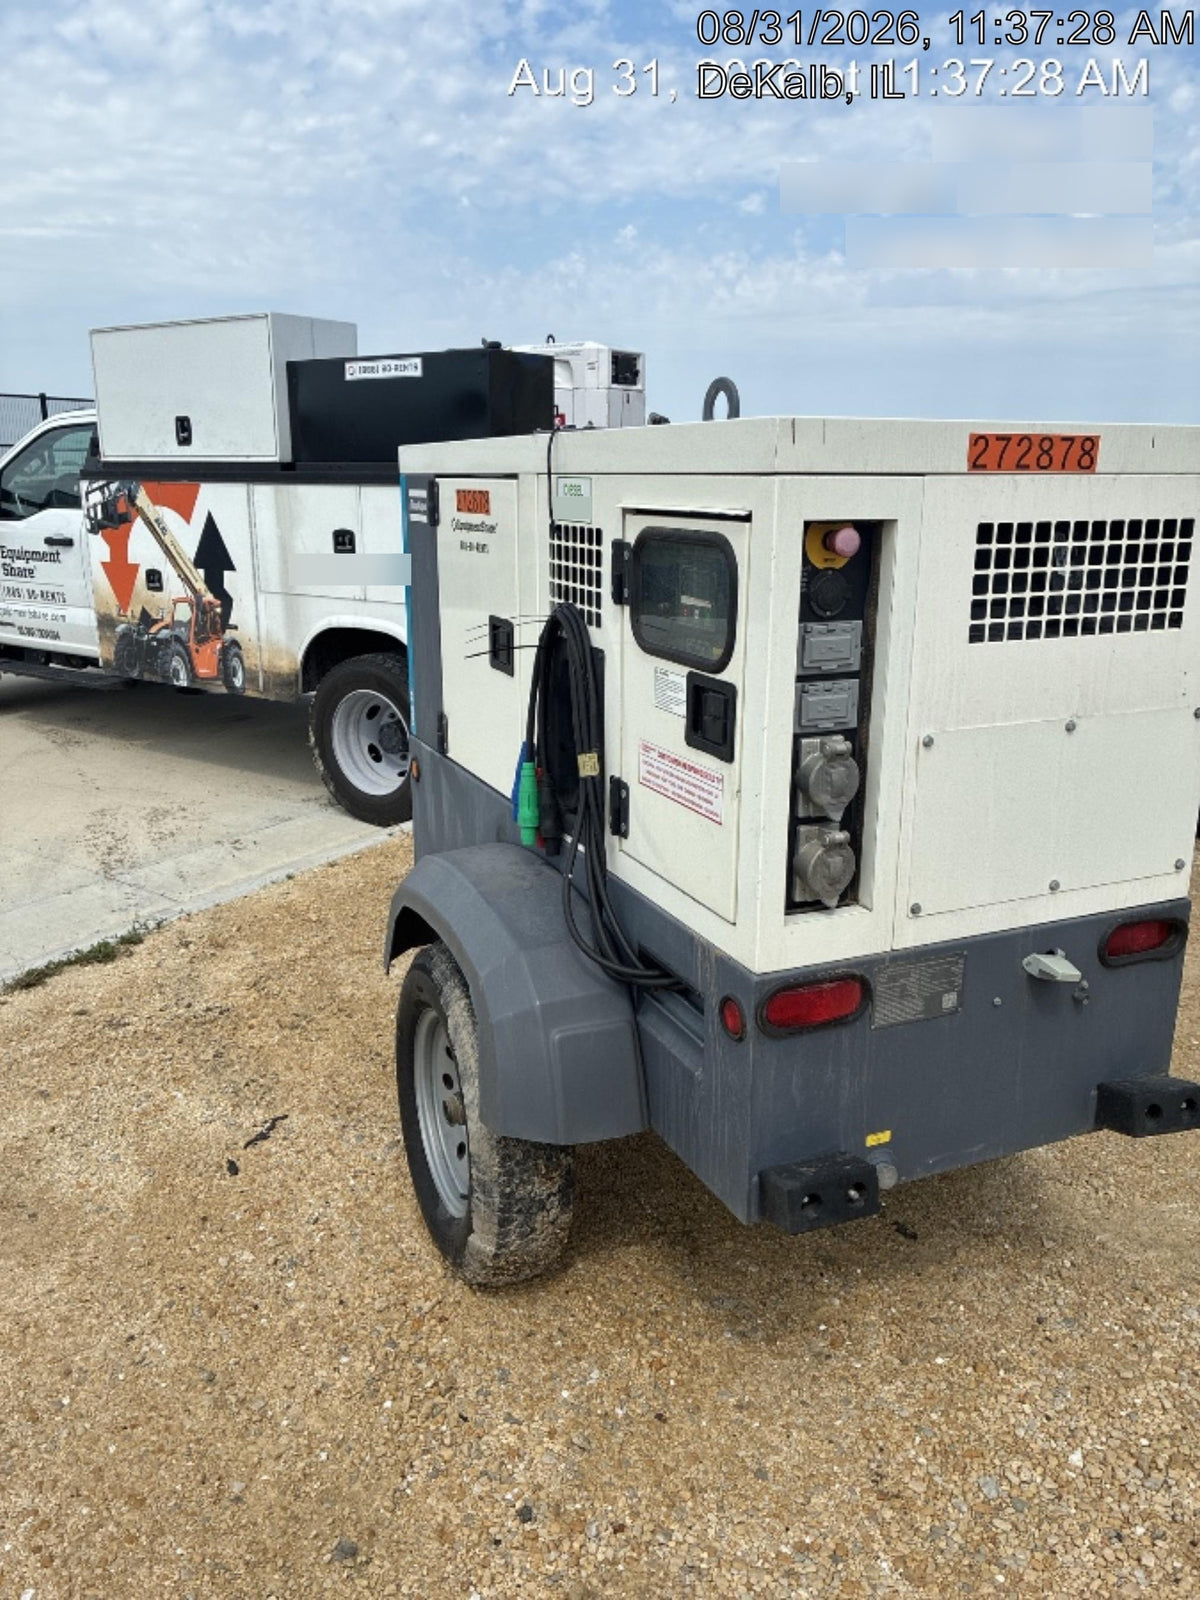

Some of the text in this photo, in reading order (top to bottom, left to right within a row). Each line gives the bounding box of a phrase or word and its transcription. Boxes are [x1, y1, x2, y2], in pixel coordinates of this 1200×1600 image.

[967, 435, 1096, 470] 272878
[0, 545, 61, 564] Equipment
[2, 563, 36, 578] Share
